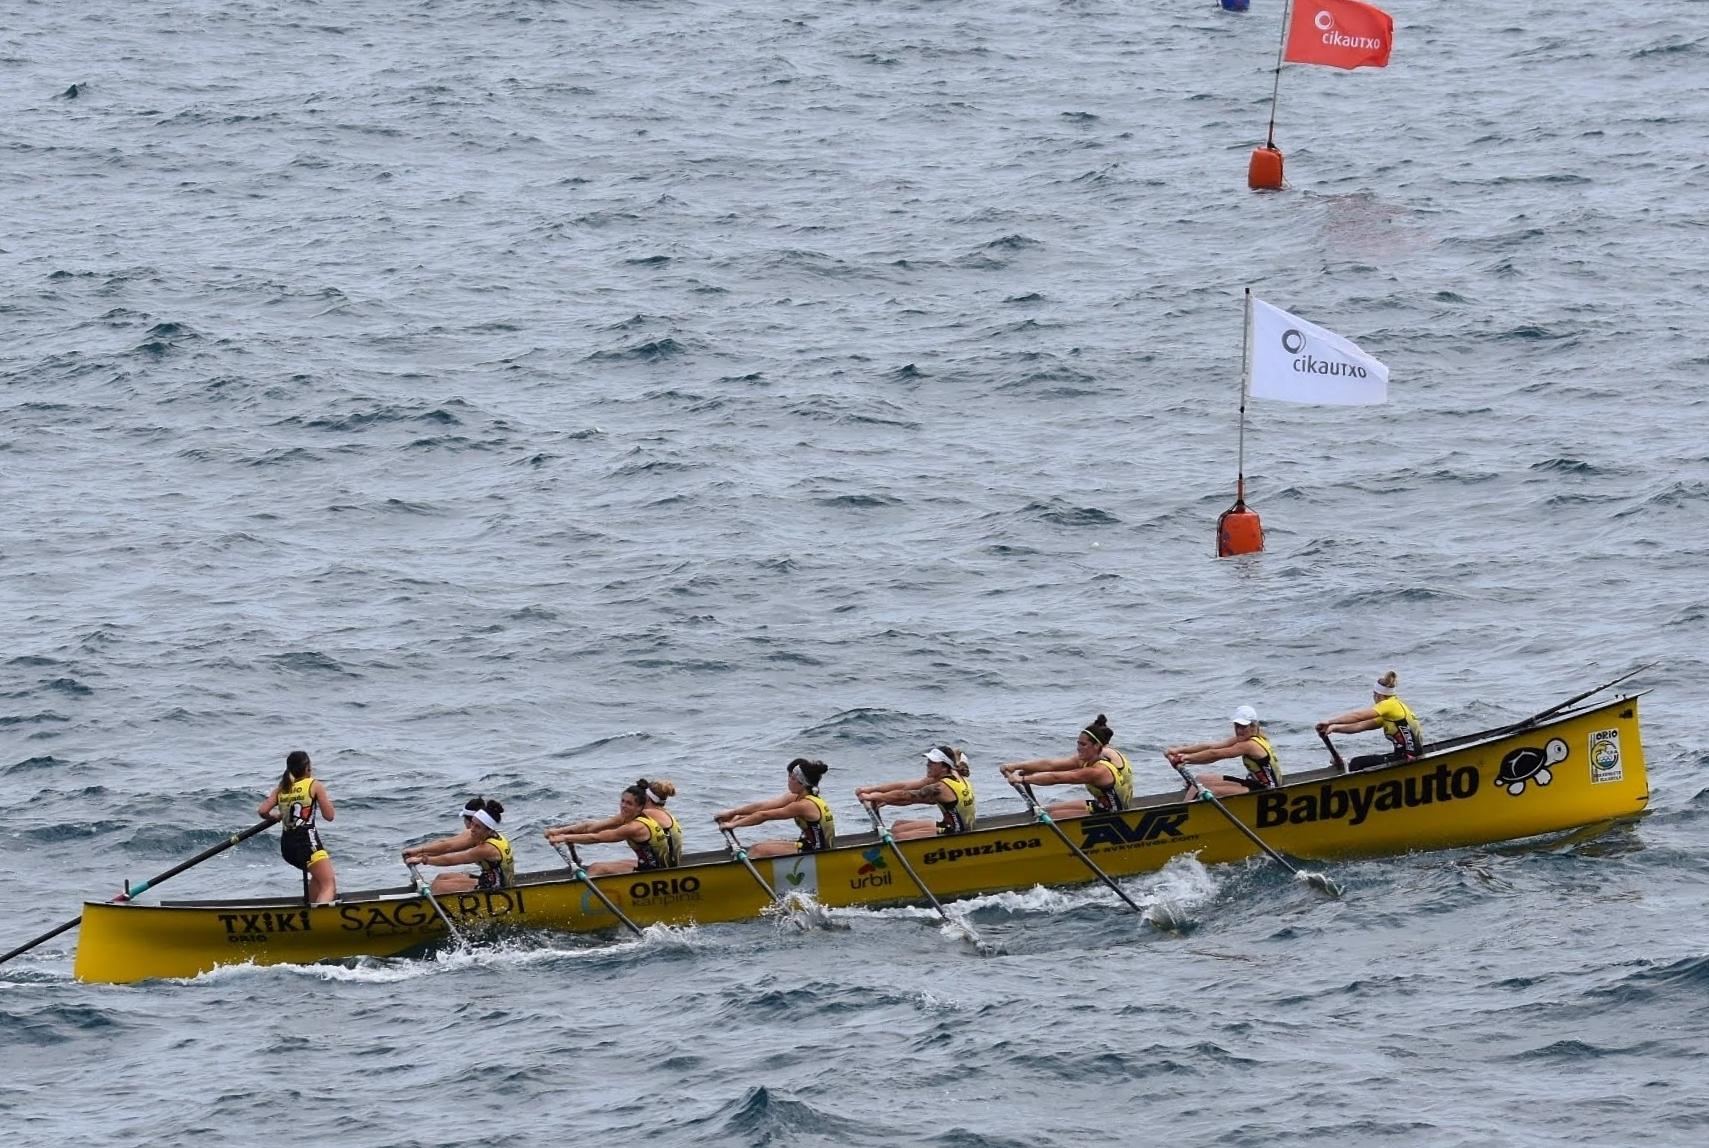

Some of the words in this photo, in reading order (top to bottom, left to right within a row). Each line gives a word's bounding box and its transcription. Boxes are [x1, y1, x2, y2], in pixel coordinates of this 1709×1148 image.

[1256, 764, 1479, 829] Babyauto
[923, 838, 1042, 865] gipuzkoa
[629, 876, 700, 899] ORIO
[850, 871, 892, 889] urbil
[340, 890, 526, 931] SAGARDI
